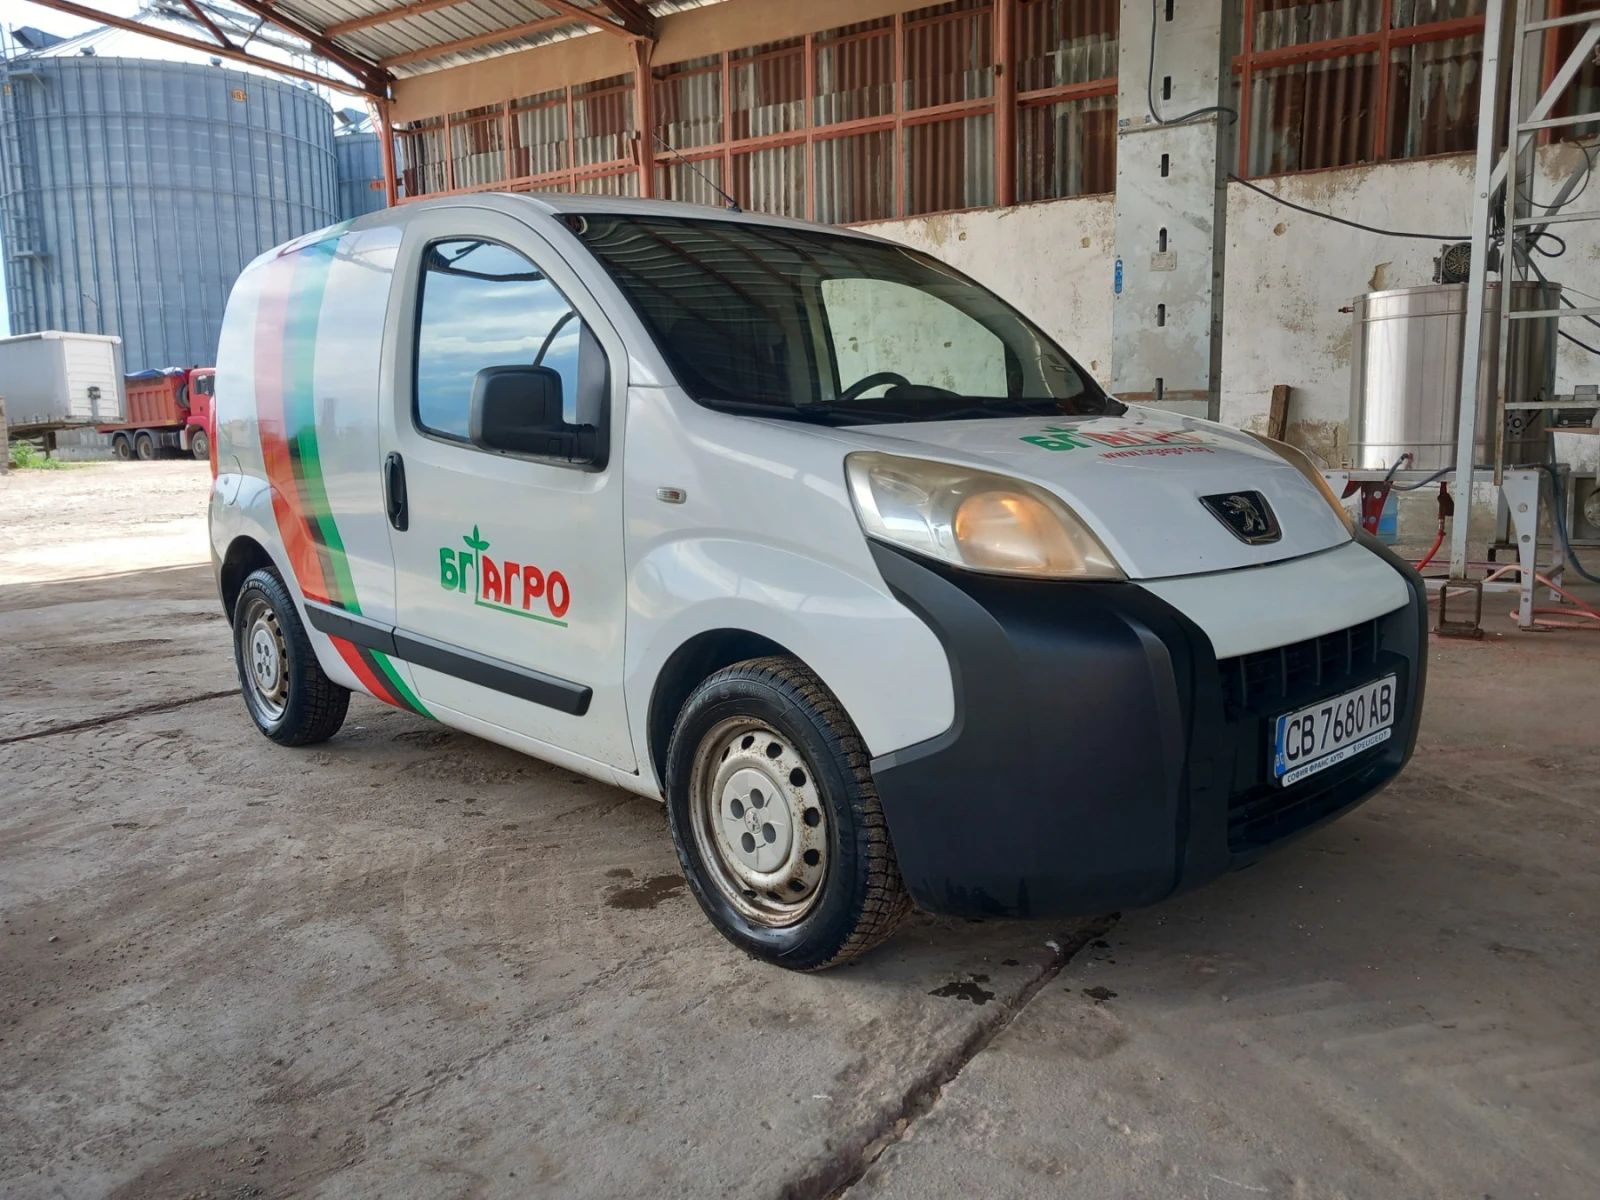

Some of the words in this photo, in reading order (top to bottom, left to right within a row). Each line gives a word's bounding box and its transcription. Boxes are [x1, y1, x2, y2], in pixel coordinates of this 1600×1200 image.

[1320, 694, 1365, 750] 7680
[1357, 731, 1388, 750] PEUGEOT
[1287, 767, 1308, 783] СОФИЯ
[1309, 758, 1329, 773] ФРАНС
[1330, 751, 1344, 763] АУТО
